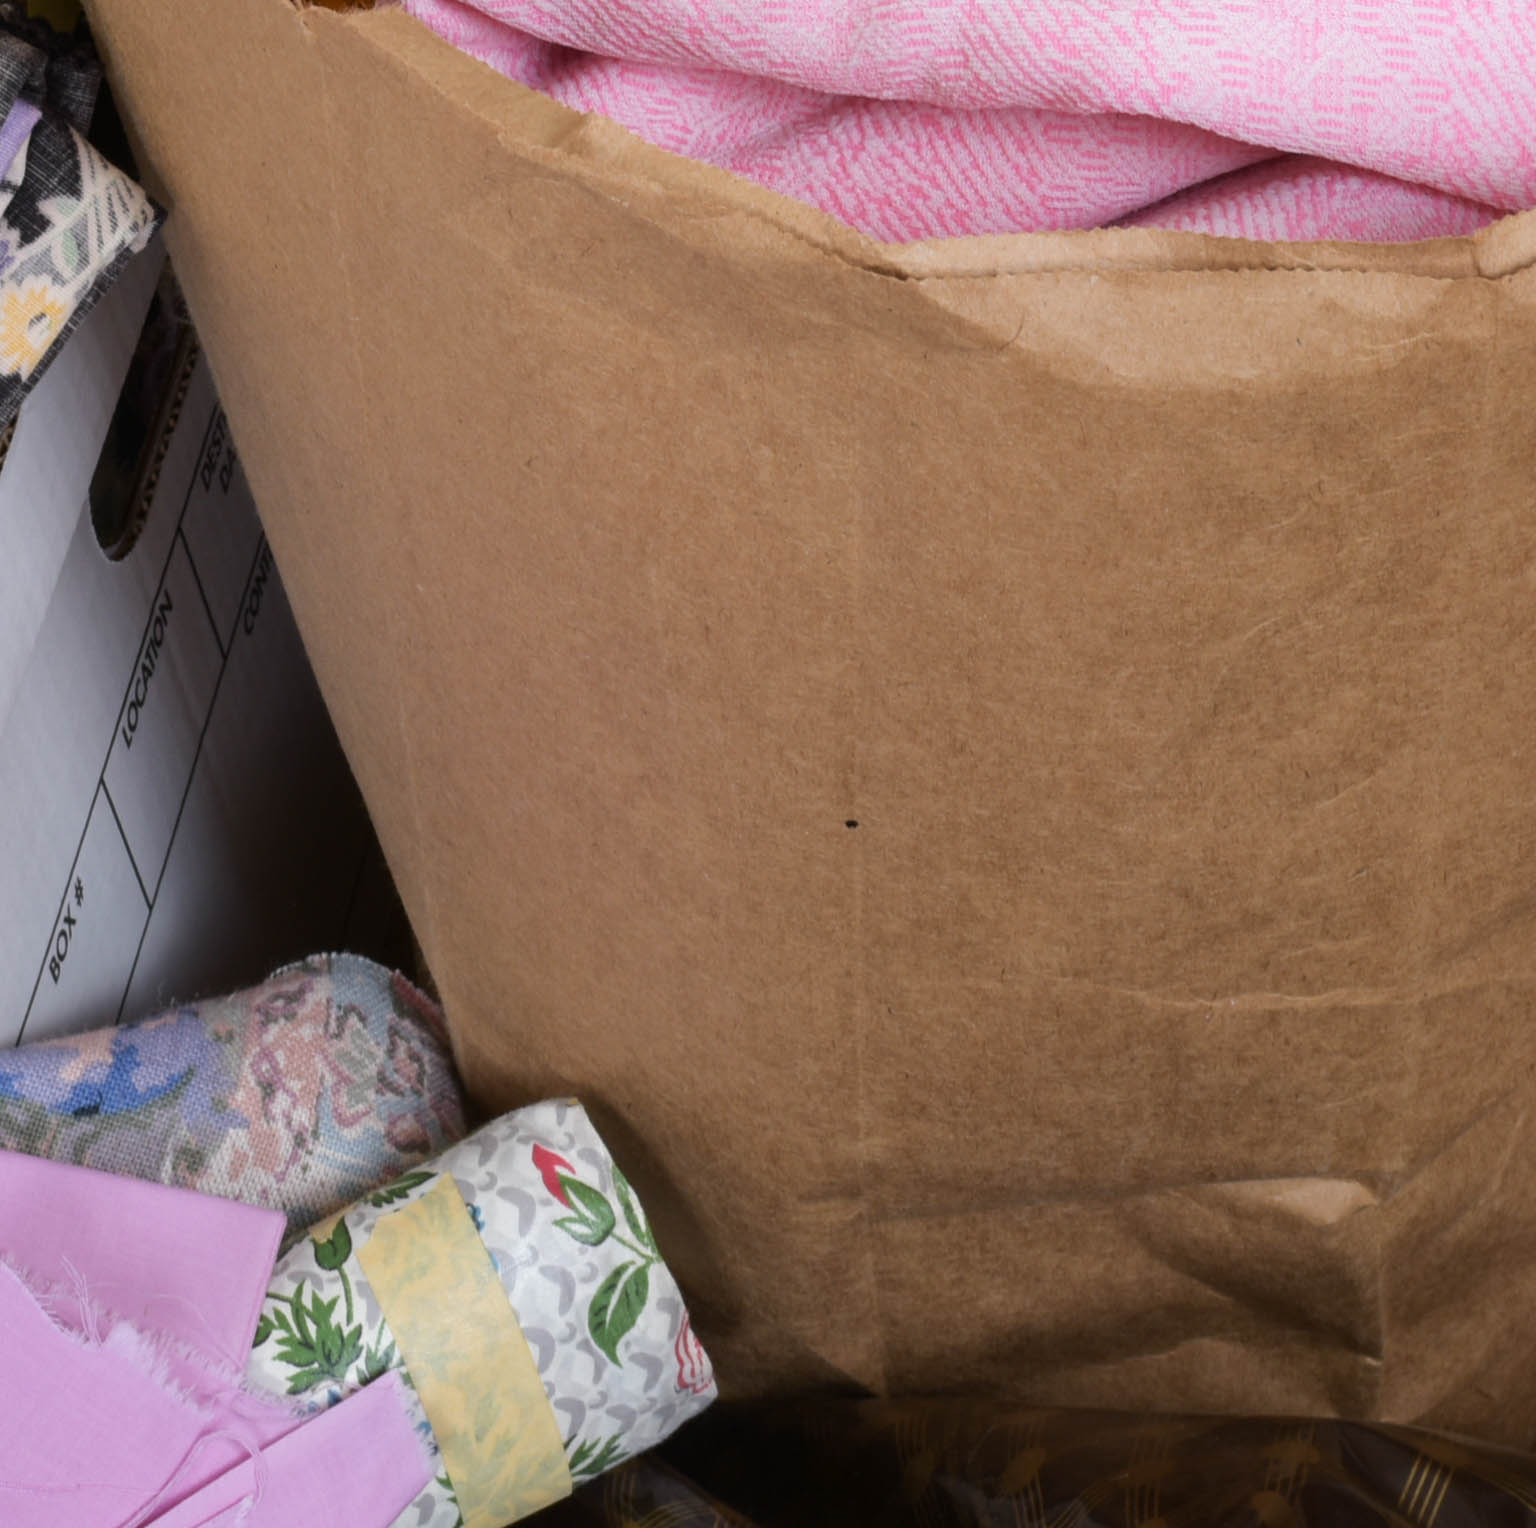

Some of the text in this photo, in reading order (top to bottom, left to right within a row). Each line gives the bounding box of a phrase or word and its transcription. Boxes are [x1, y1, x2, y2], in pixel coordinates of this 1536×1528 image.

[122, 588, 174, 750] LOCATION
[49, 875, 85, 985] BOX #
